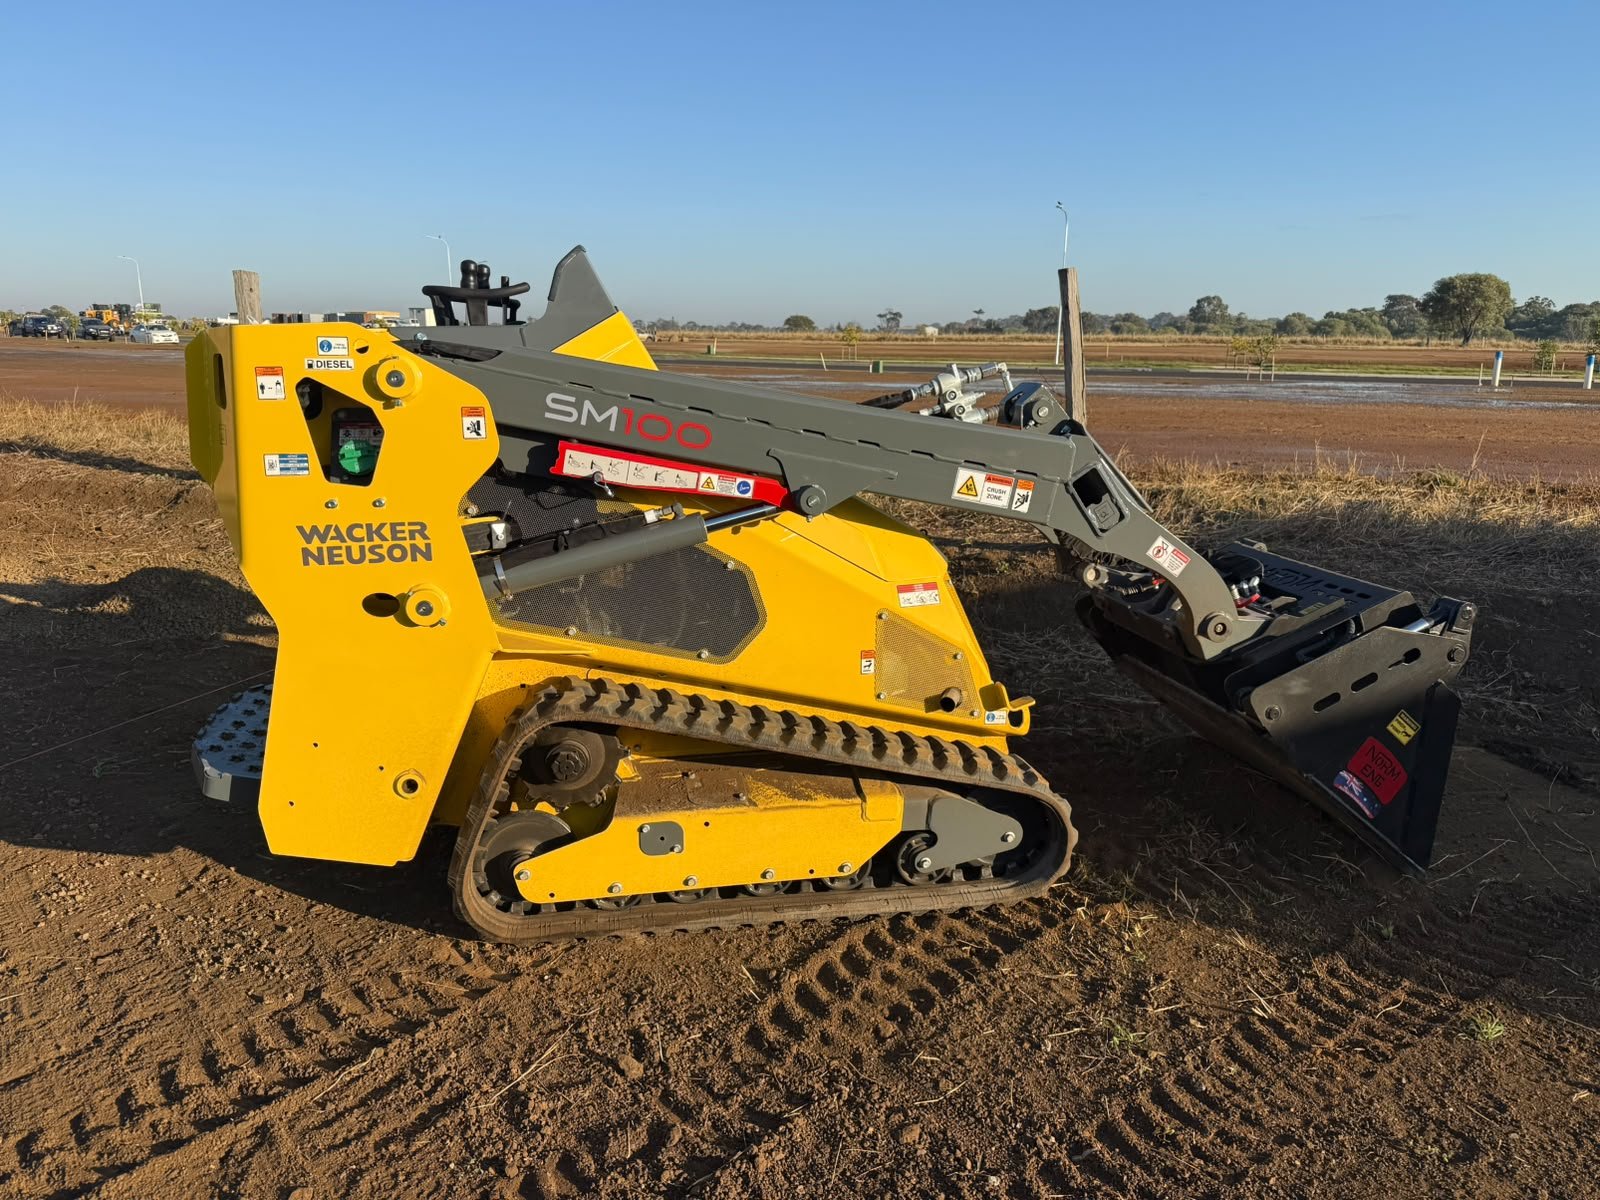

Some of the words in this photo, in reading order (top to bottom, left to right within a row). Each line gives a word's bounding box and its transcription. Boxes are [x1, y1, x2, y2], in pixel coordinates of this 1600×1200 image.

[316, 360, 352, 368] DIESEL
[544, 392, 712, 450] SM100
[987, 487, 1007, 495] CRUSH
[296, 521, 431, 544] WACKER
[301, 543, 432, 566] NEUSON
[1365, 745, 1400, 781] NORM
[1361, 763, 1384, 788] ENG
